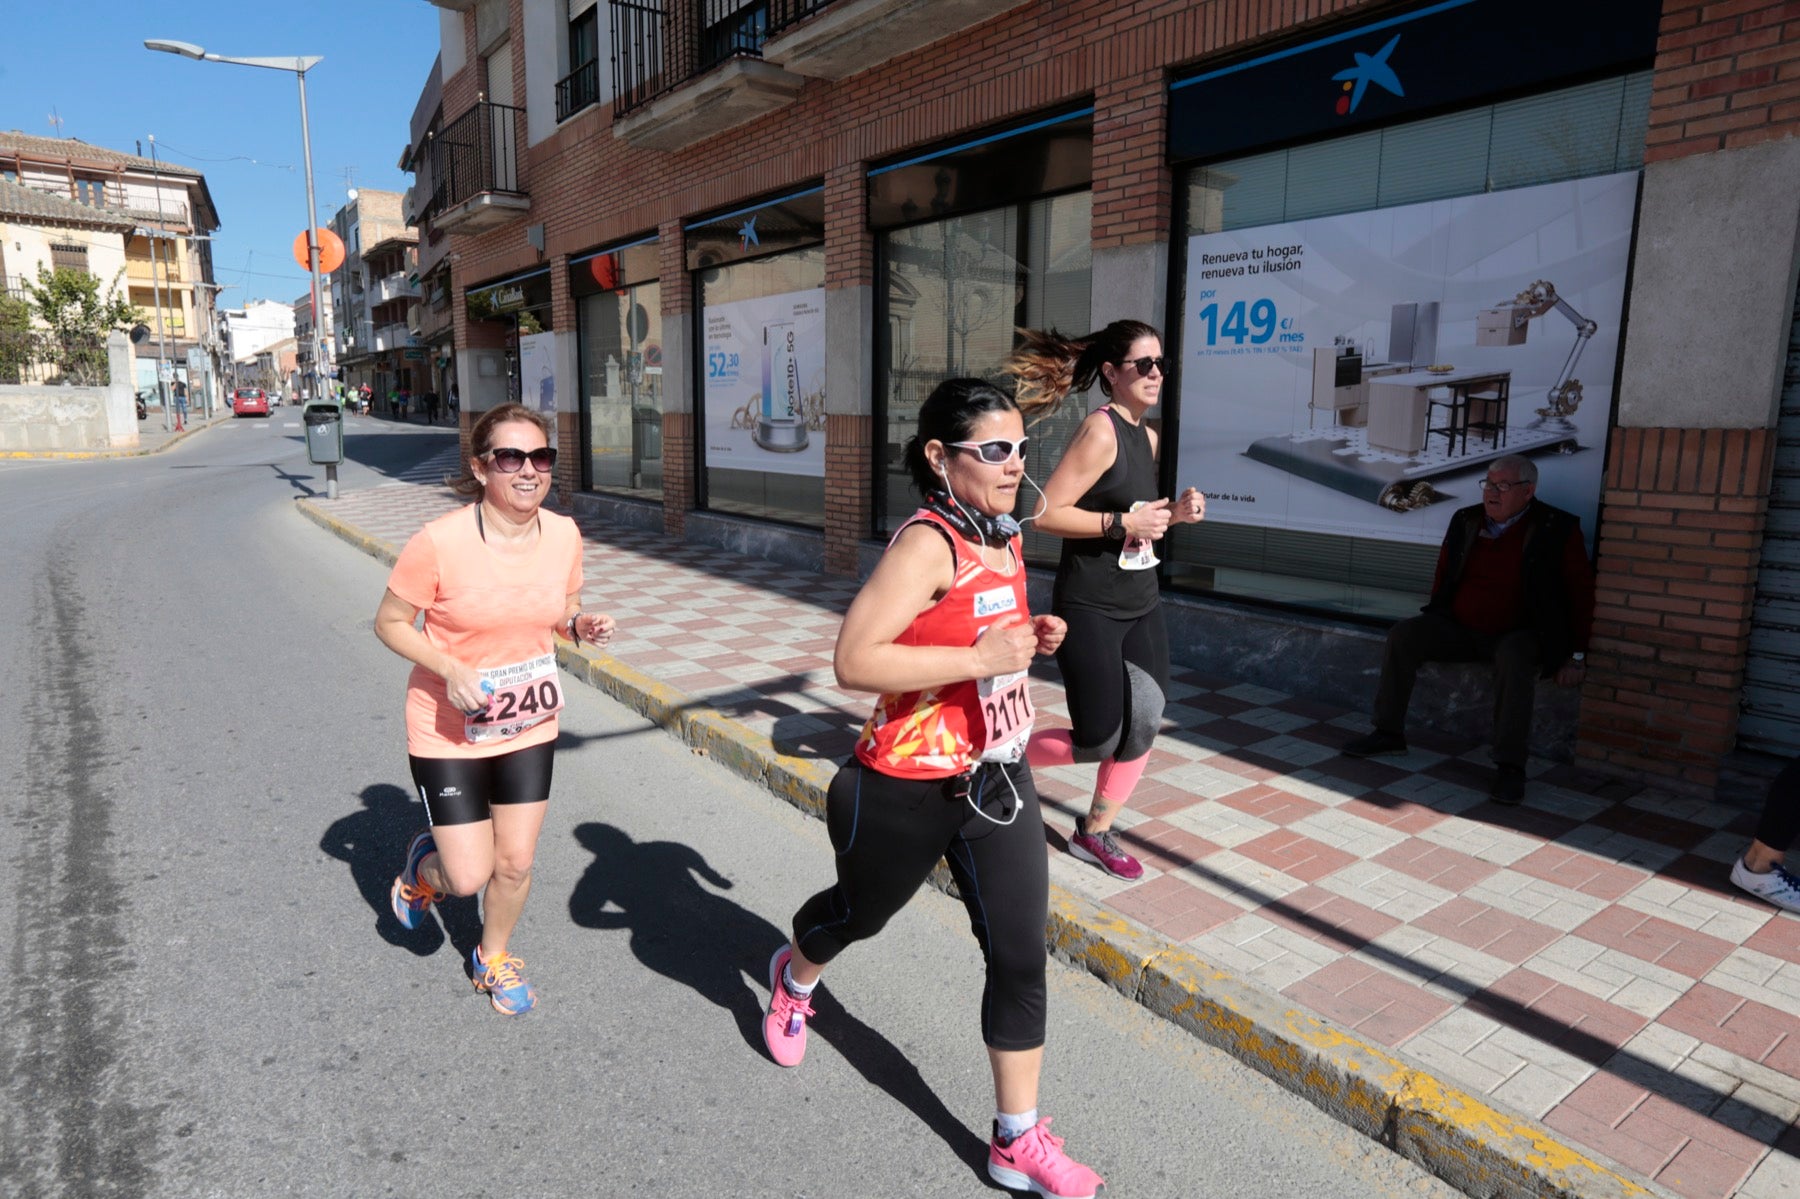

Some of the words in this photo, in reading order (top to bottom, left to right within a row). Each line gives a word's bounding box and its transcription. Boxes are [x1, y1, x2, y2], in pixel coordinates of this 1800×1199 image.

[1201, 251, 1248, 266] Renueva
[1251, 248, 1264, 260] tu
[1266, 244, 1304, 259] hogar,
[1201, 266, 1245, 280] renueva
[1248, 264, 1260, 275] tu
[1263, 258, 1301, 273] ilusión
[1200, 289, 1216, 301] por
[1199, 298, 1277, 347] 149
[787, 331, 794, 353] 5G
[1280, 332, 1304, 343] mes
[1221, 493, 1230, 501] de
[1232, 494, 1239, 502] la
[1240, 495, 1256, 503] vida
[490, 668, 507, 680] GRAN
[508, 663, 529, 677] PREMIO
[528, 662, 535, 671] DE
[985, 683, 1030, 741] 2171
